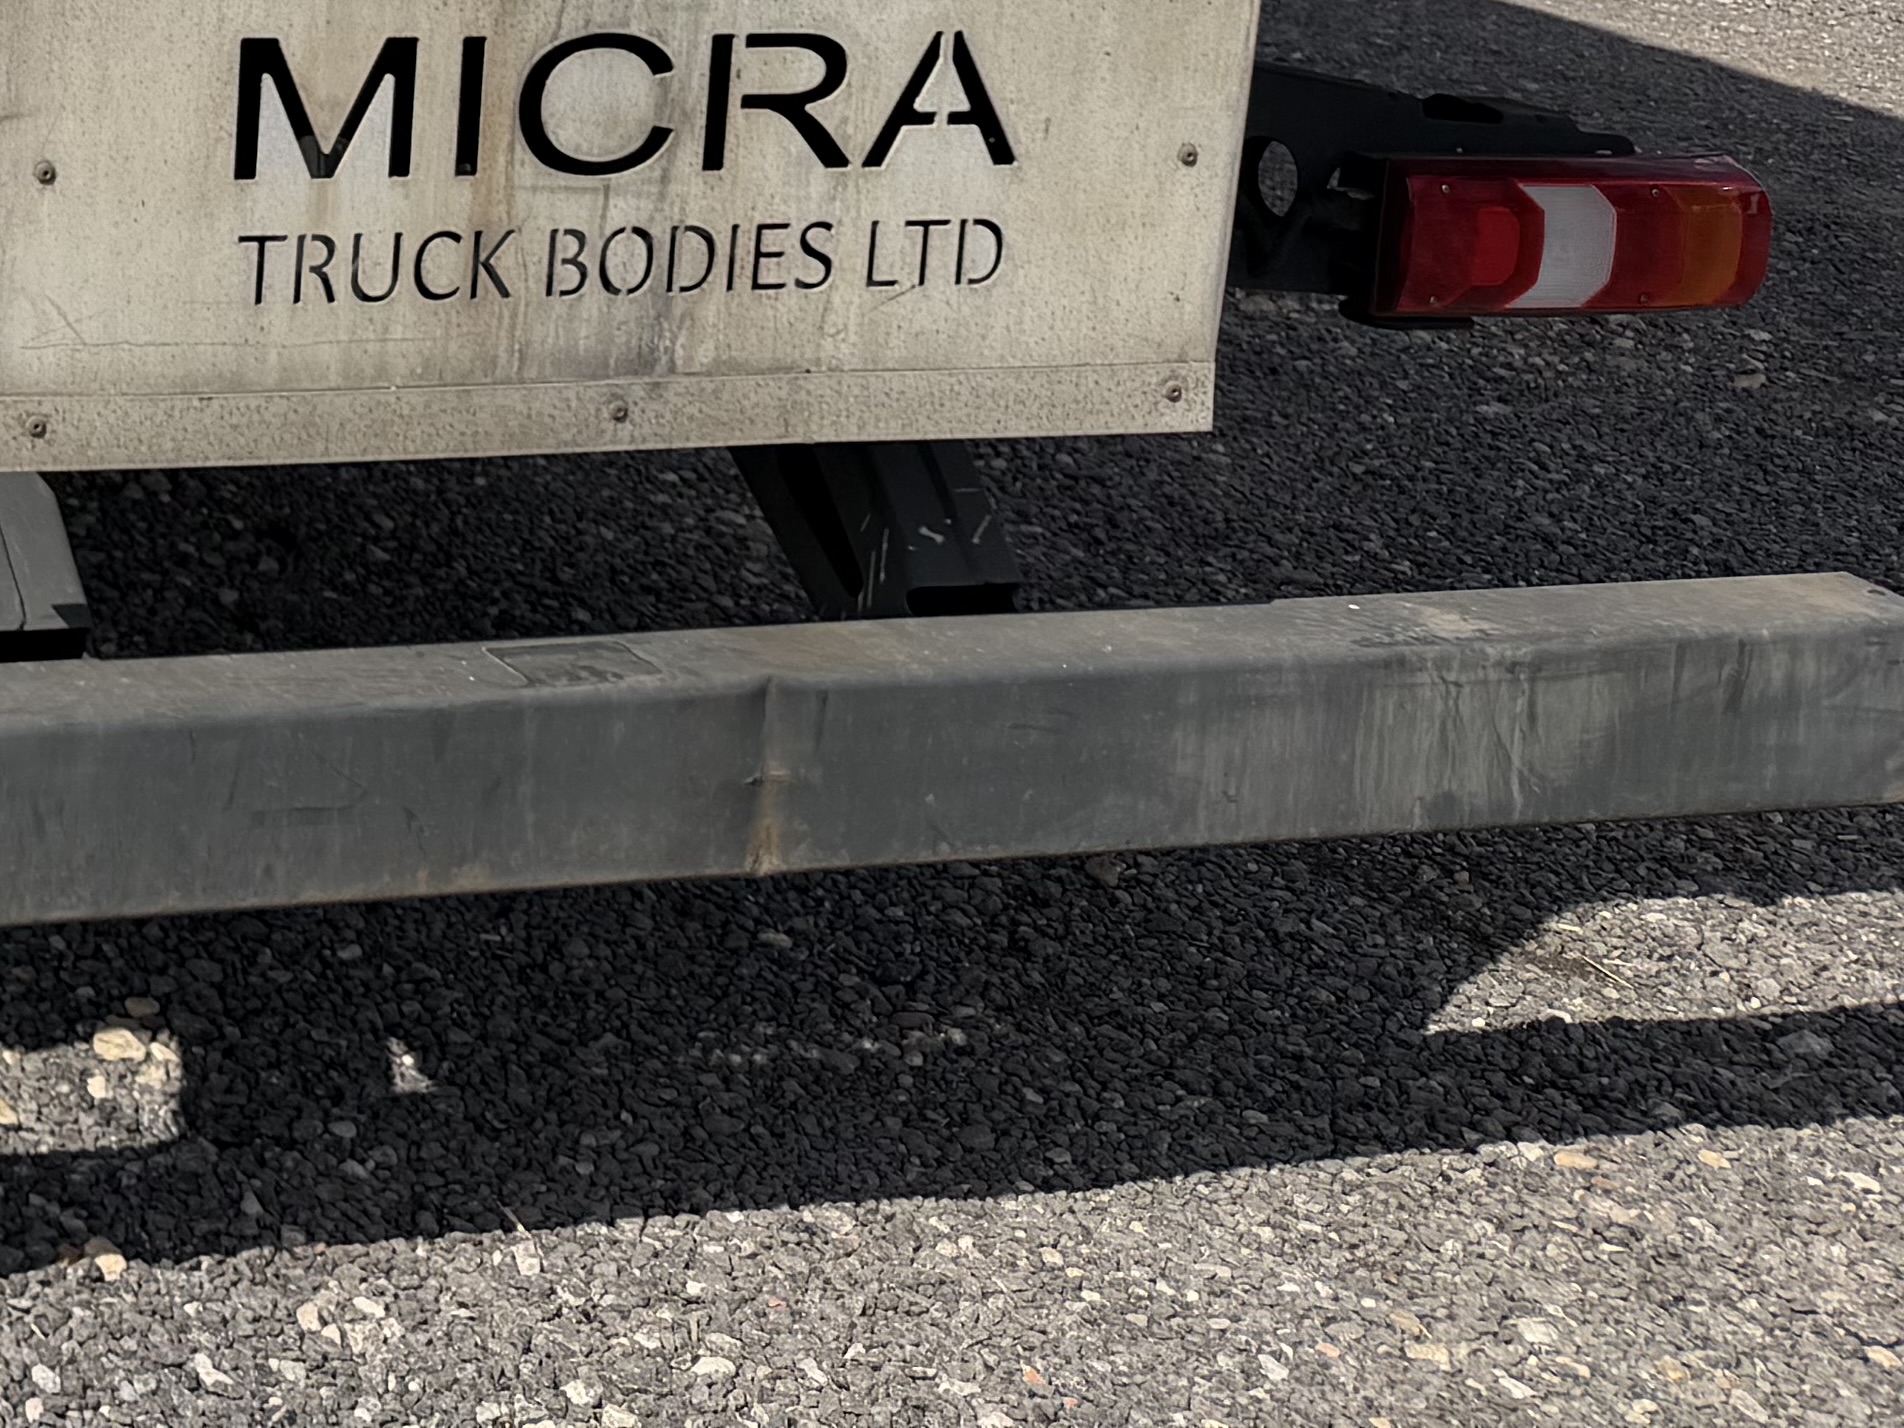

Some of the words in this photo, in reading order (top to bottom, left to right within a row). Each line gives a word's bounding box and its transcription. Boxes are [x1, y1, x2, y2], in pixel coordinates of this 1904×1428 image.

[233, 29, 1017, 181] MICRA
[237, 229, 517, 306] TRUCK
[545, 220, 835, 298] BODIES
[865, 218, 1004, 288] LTD
